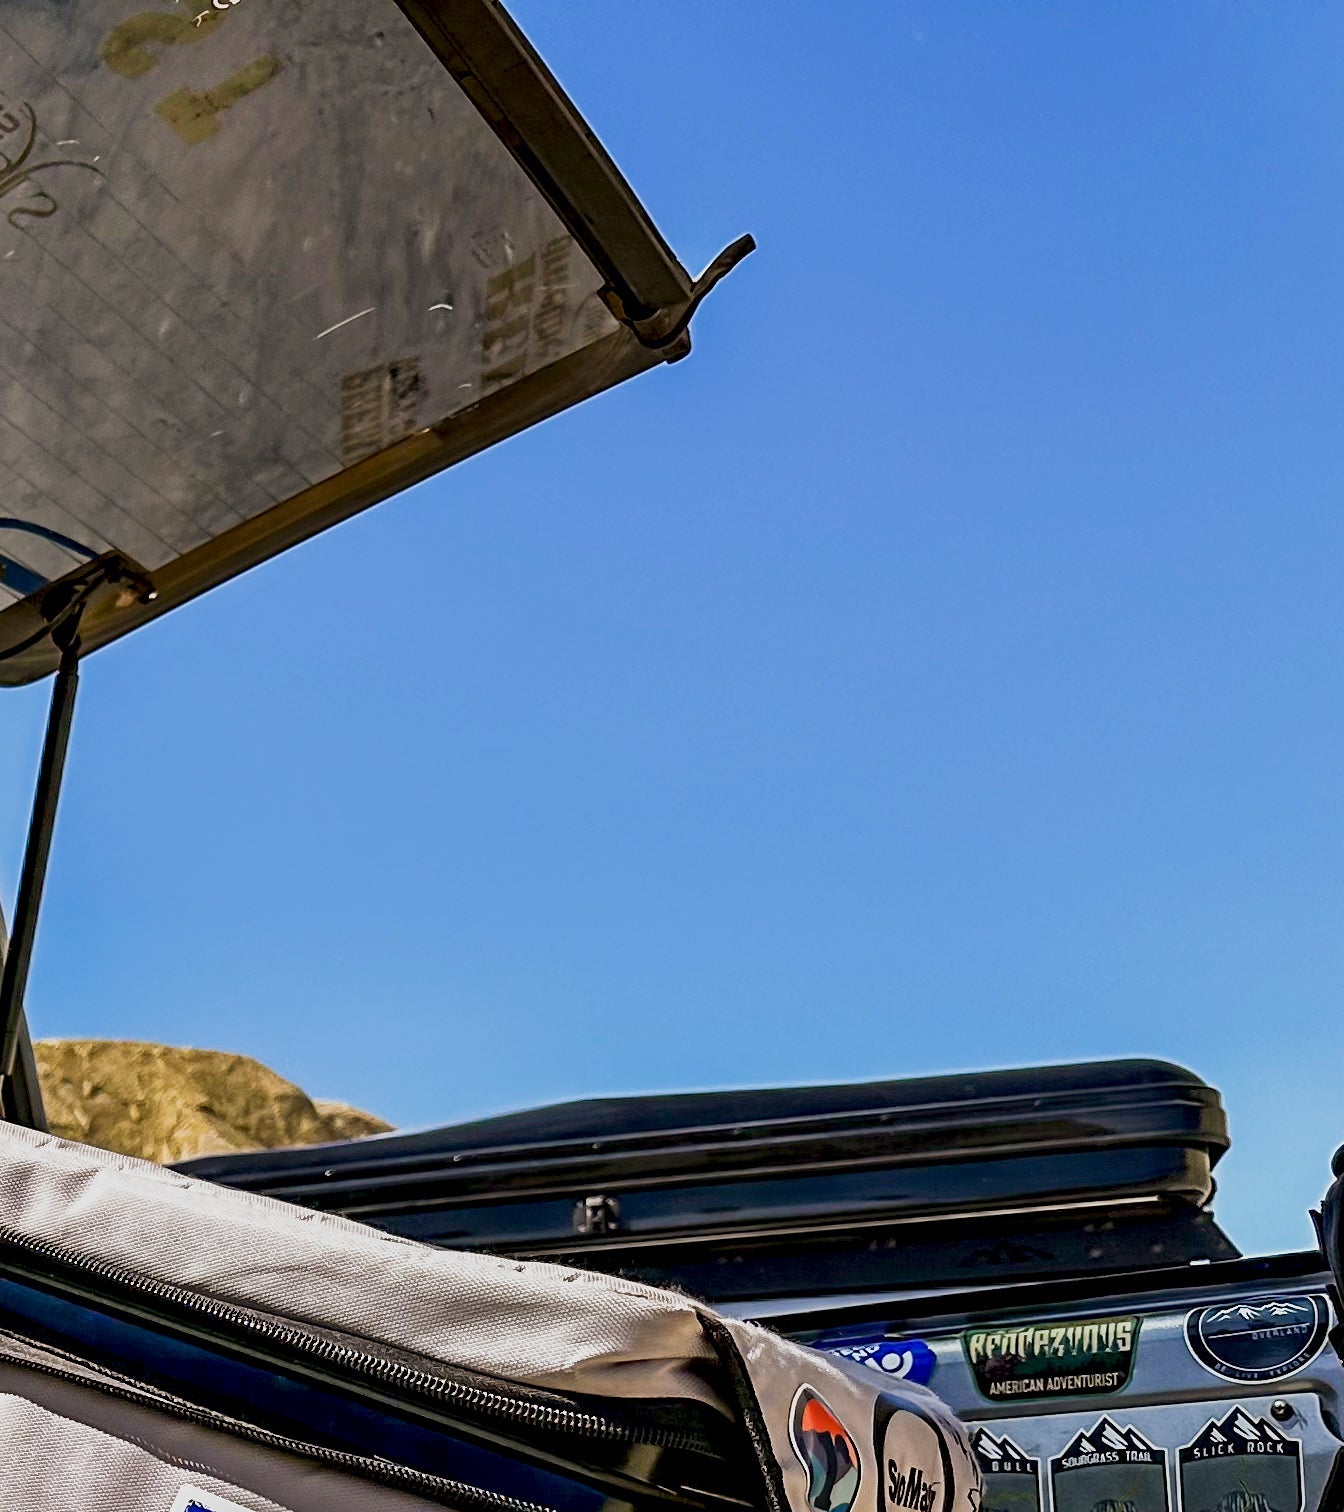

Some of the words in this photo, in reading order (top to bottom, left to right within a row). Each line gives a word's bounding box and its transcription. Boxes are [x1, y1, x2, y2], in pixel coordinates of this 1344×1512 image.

[1251, 1325, 1308, 1341] OVERLAND
[989, 1378, 1044, 1396] AMERICAN
[1046, 1371, 1120, 1393] ADVENTURIST
[1193, 1445, 1235, 1459] SLICK
[1246, 1442, 1285, 1454] ROCK
[1061, 1451, 1120, 1469] SOURGRASS
